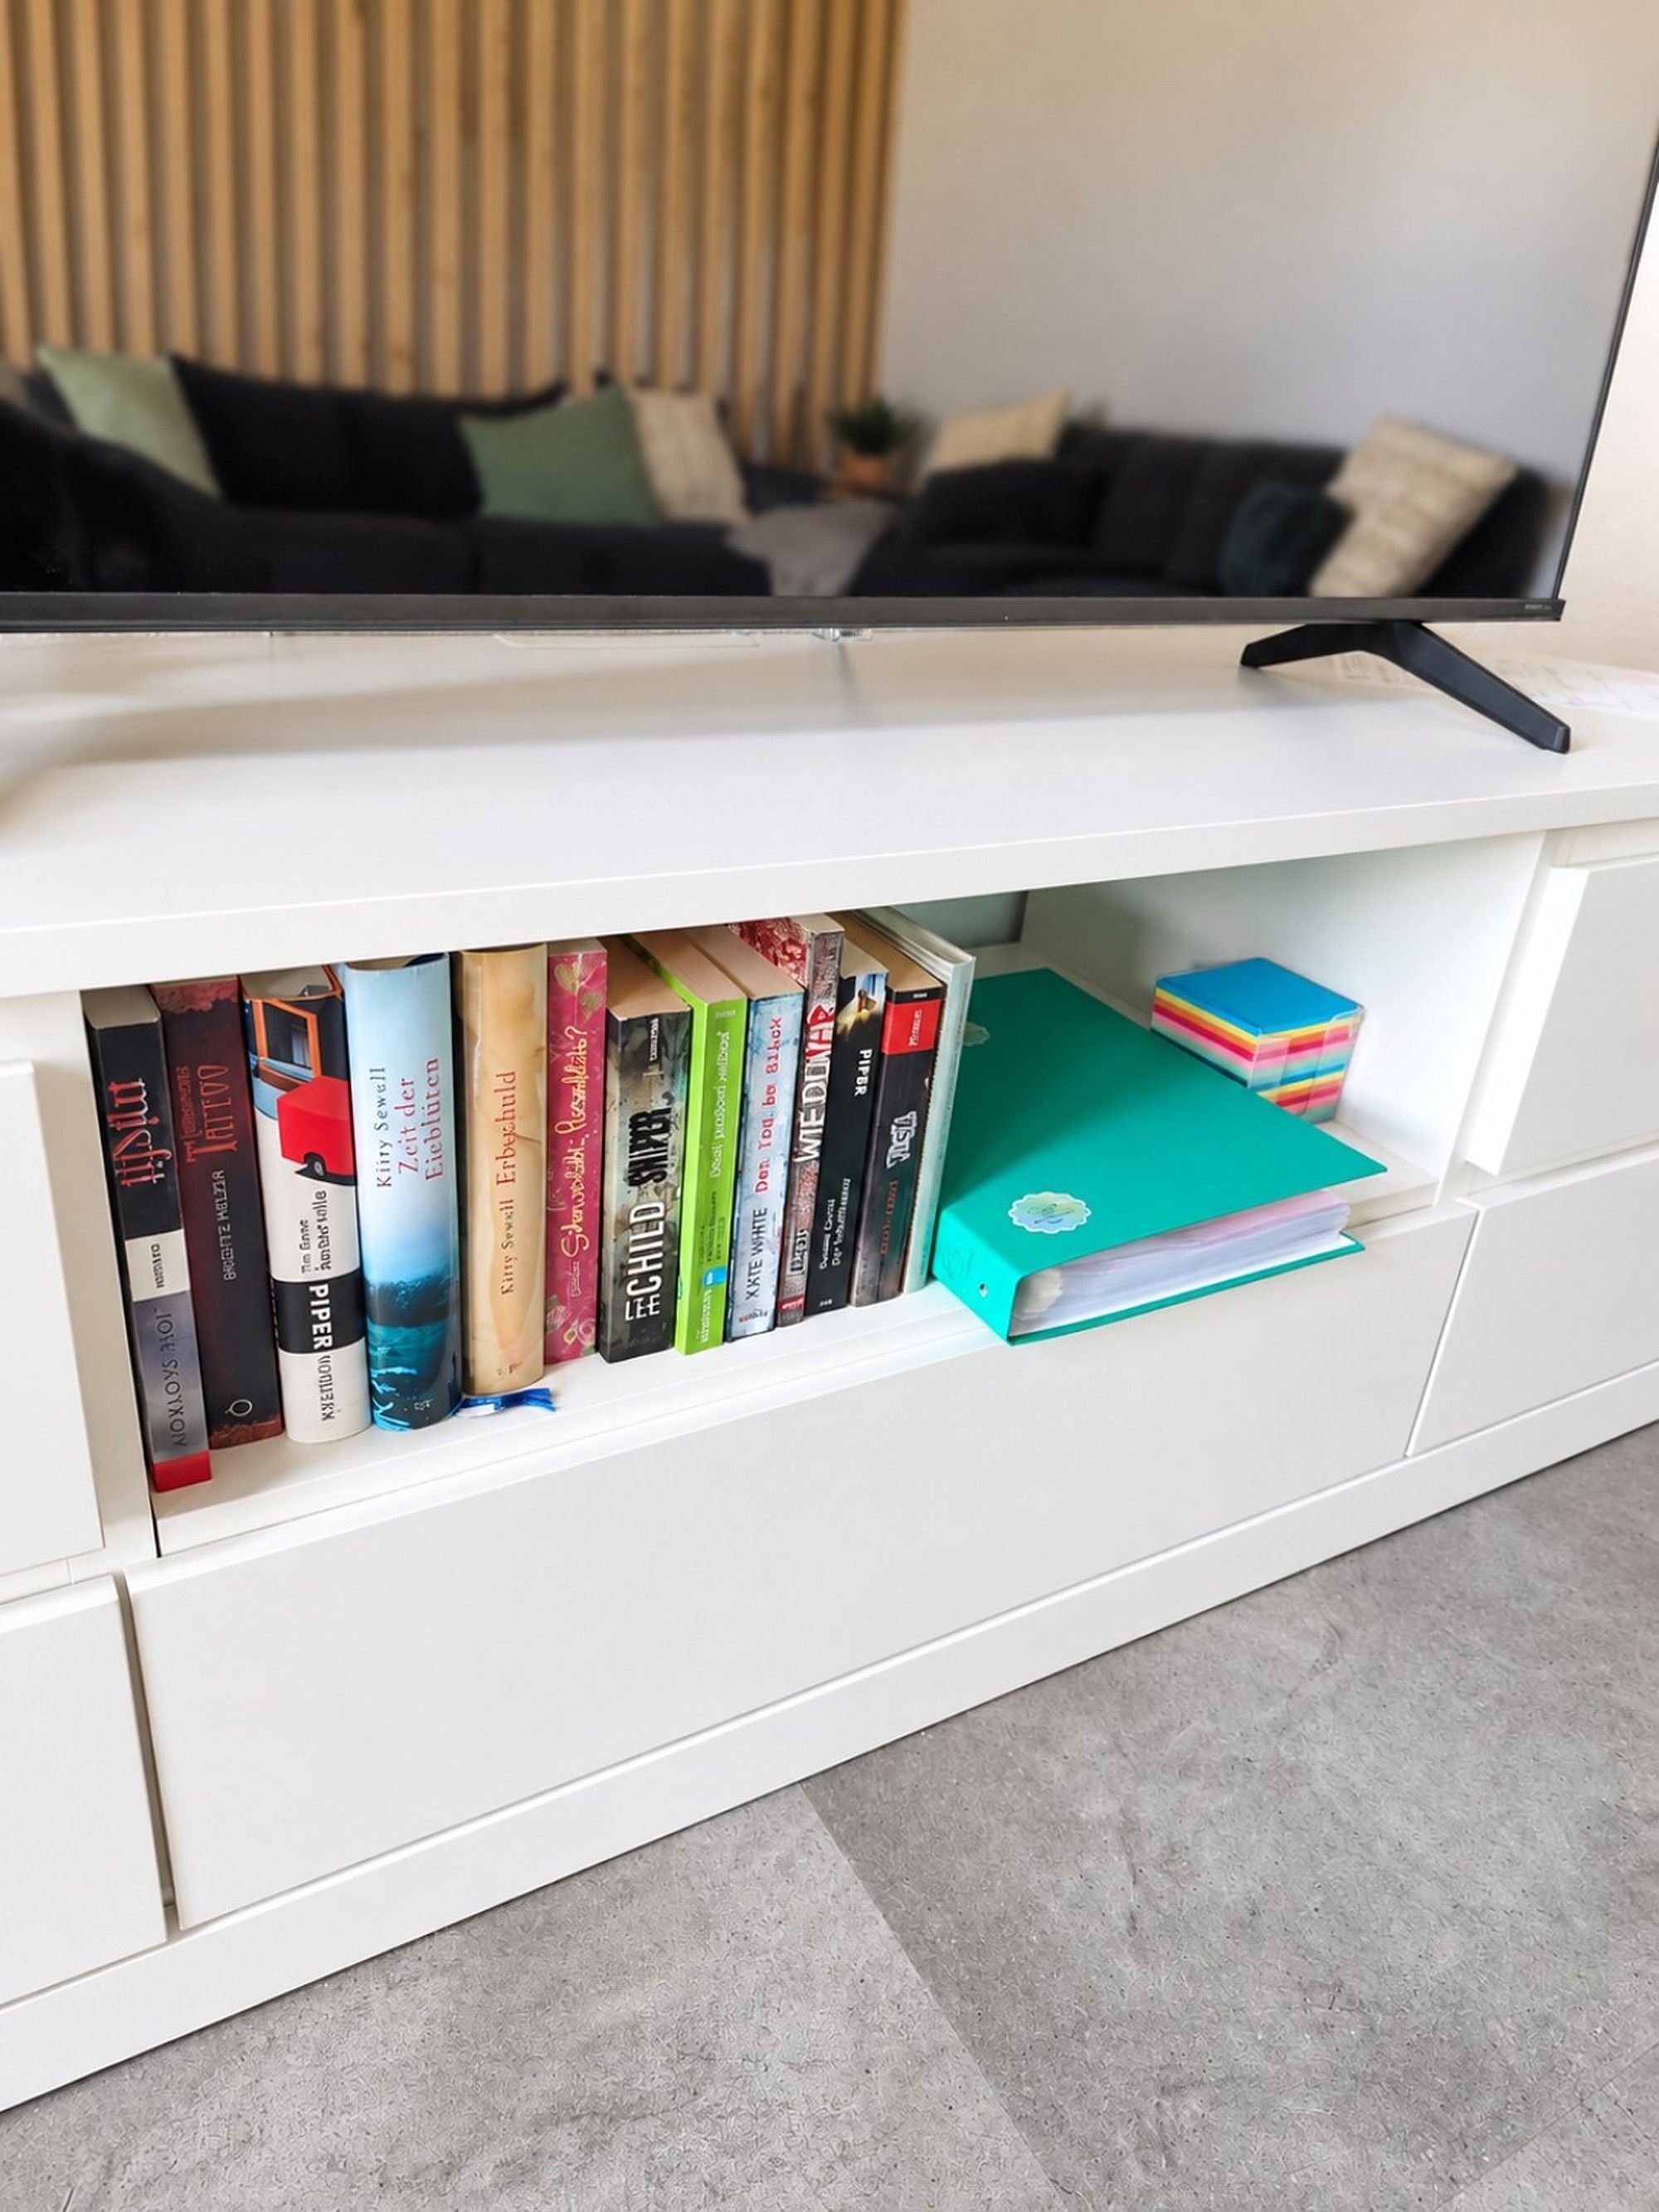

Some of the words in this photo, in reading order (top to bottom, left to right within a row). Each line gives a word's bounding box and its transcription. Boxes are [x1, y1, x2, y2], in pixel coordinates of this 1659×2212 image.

[370, 1067, 388, 1131] Sewell
[394, 1077, 416, 1116] der
[396, 1125, 419, 1174] Zeit
[625, 1201, 665, 1296] CHILD
[308, 1283, 333, 1349] PIPER
